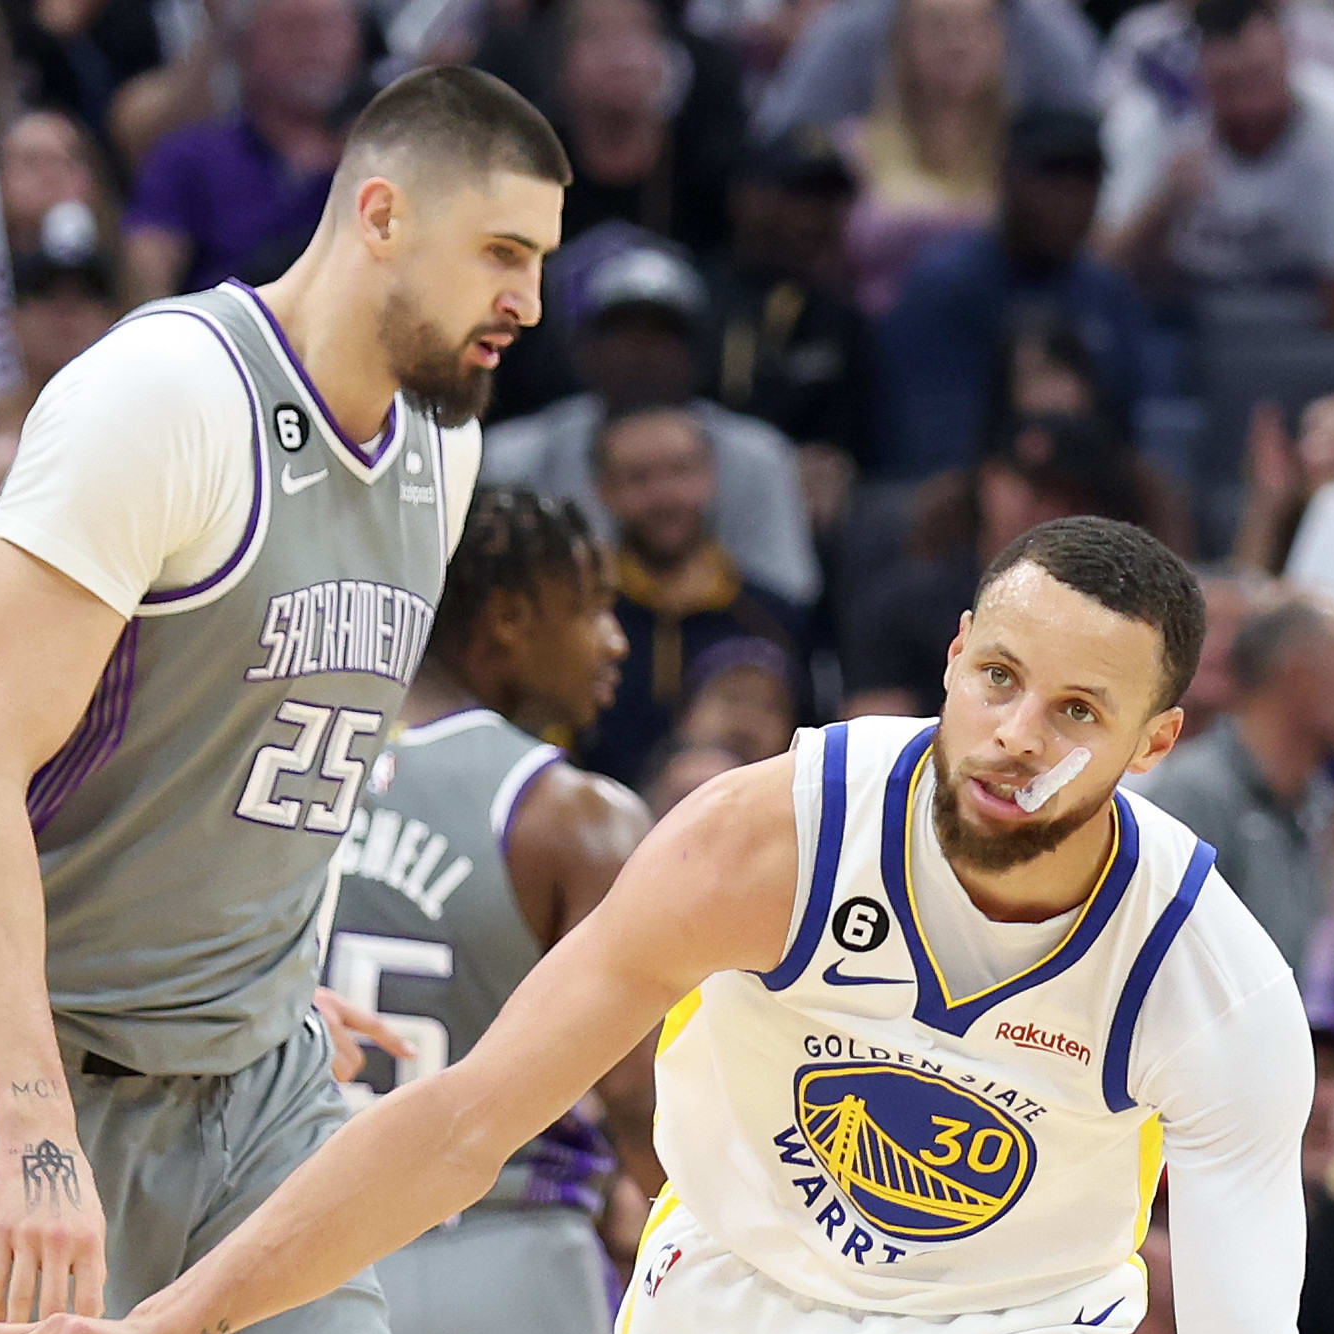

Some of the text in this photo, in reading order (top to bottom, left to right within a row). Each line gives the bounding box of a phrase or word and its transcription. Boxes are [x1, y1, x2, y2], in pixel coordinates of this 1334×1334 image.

[276, 408, 303, 449] 6
[234, 699, 384, 835] 25
[841, 903, 879, 948] 6
[803, 1034, 944, 1074] GOLDEN
[994, 1022, 1091, 1066] Rakuten
[919, 1114, 1013, 1174] 30
